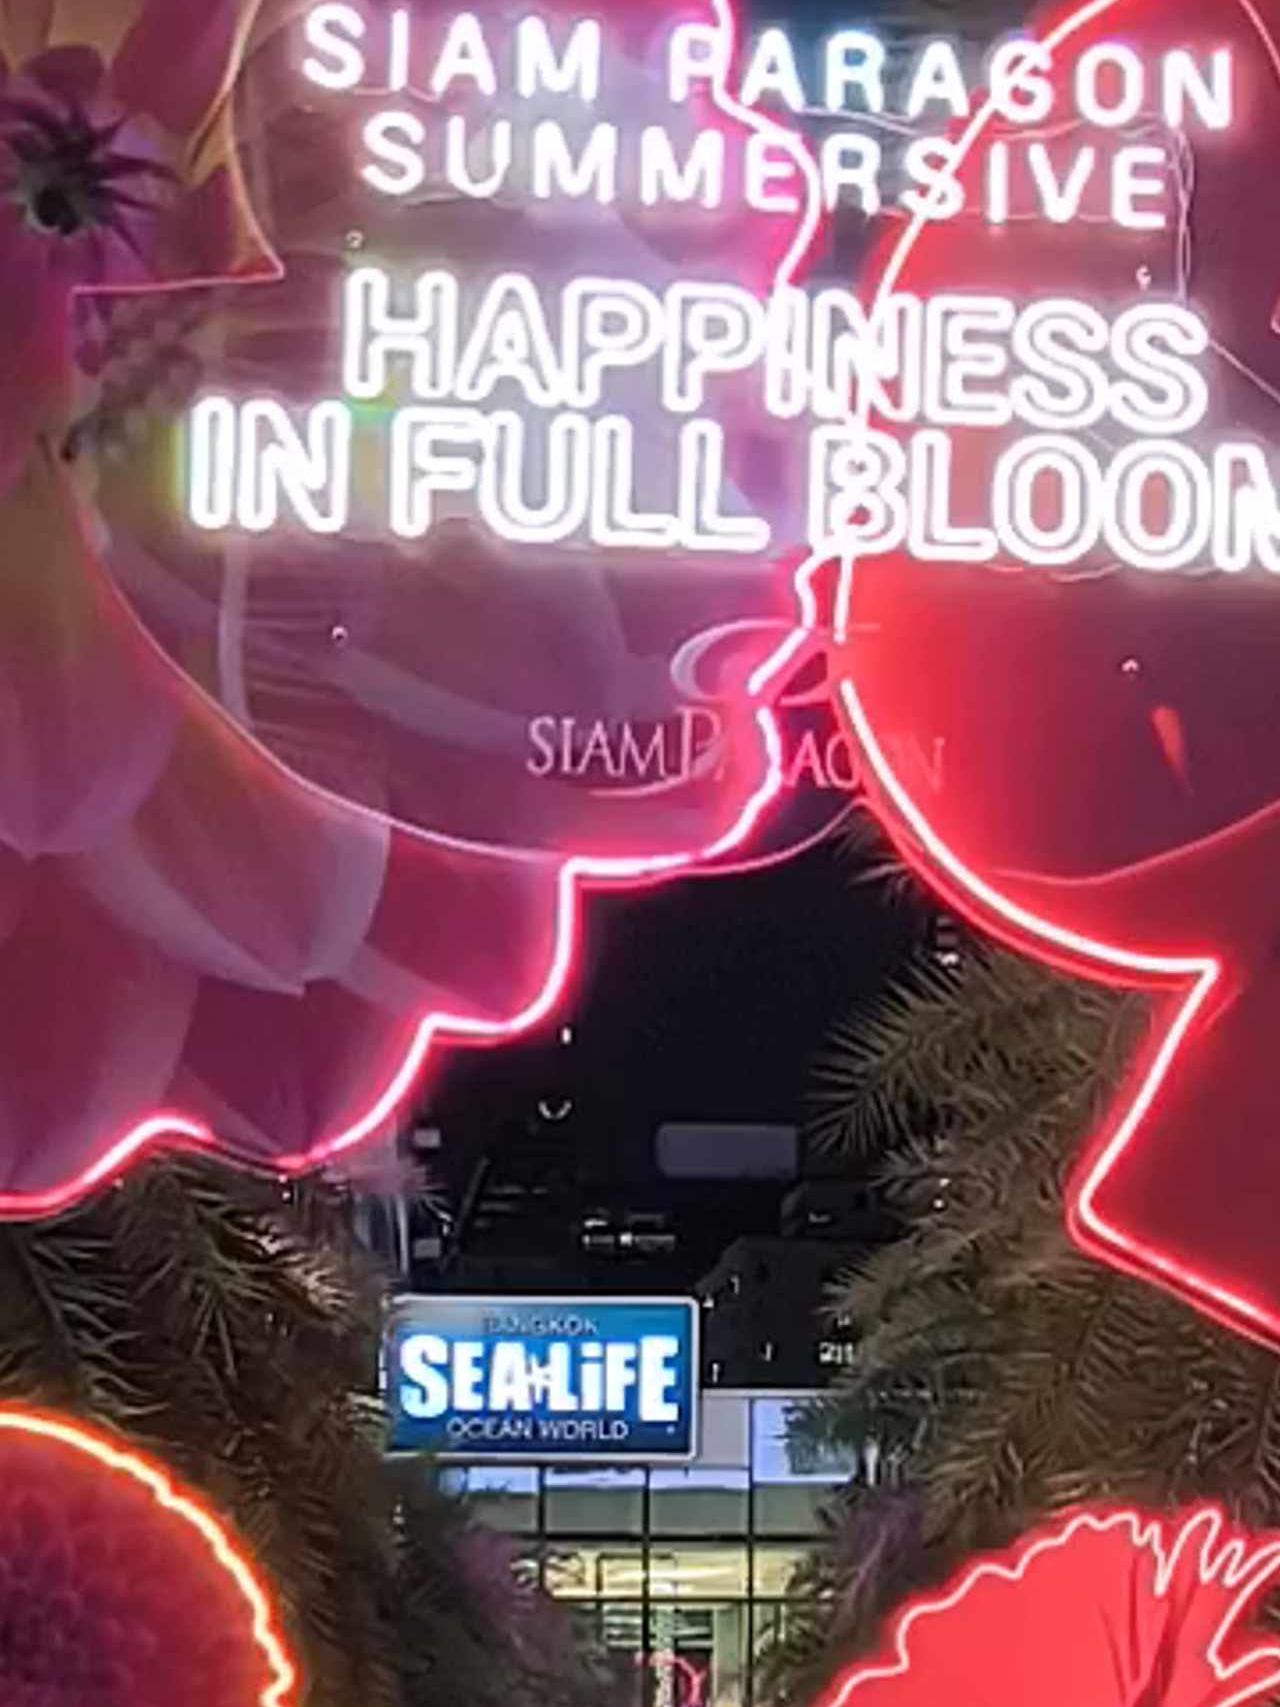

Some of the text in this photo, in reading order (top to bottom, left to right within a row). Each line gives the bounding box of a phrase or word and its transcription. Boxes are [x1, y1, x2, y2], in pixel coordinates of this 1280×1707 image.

[301, 2, 1233, 131] SIAM PARAGON
[360, 111, 1168, 230] SUMMERSIVE
[341, 267, 1210, 434] HAPPINESS
[188, 396, 353, 534] IN
[389, 406, 771, 552] FULL
[400, 1334, 533, 1419] SEA
[447, 1416, 630, 1442] OCEAN WORLD
